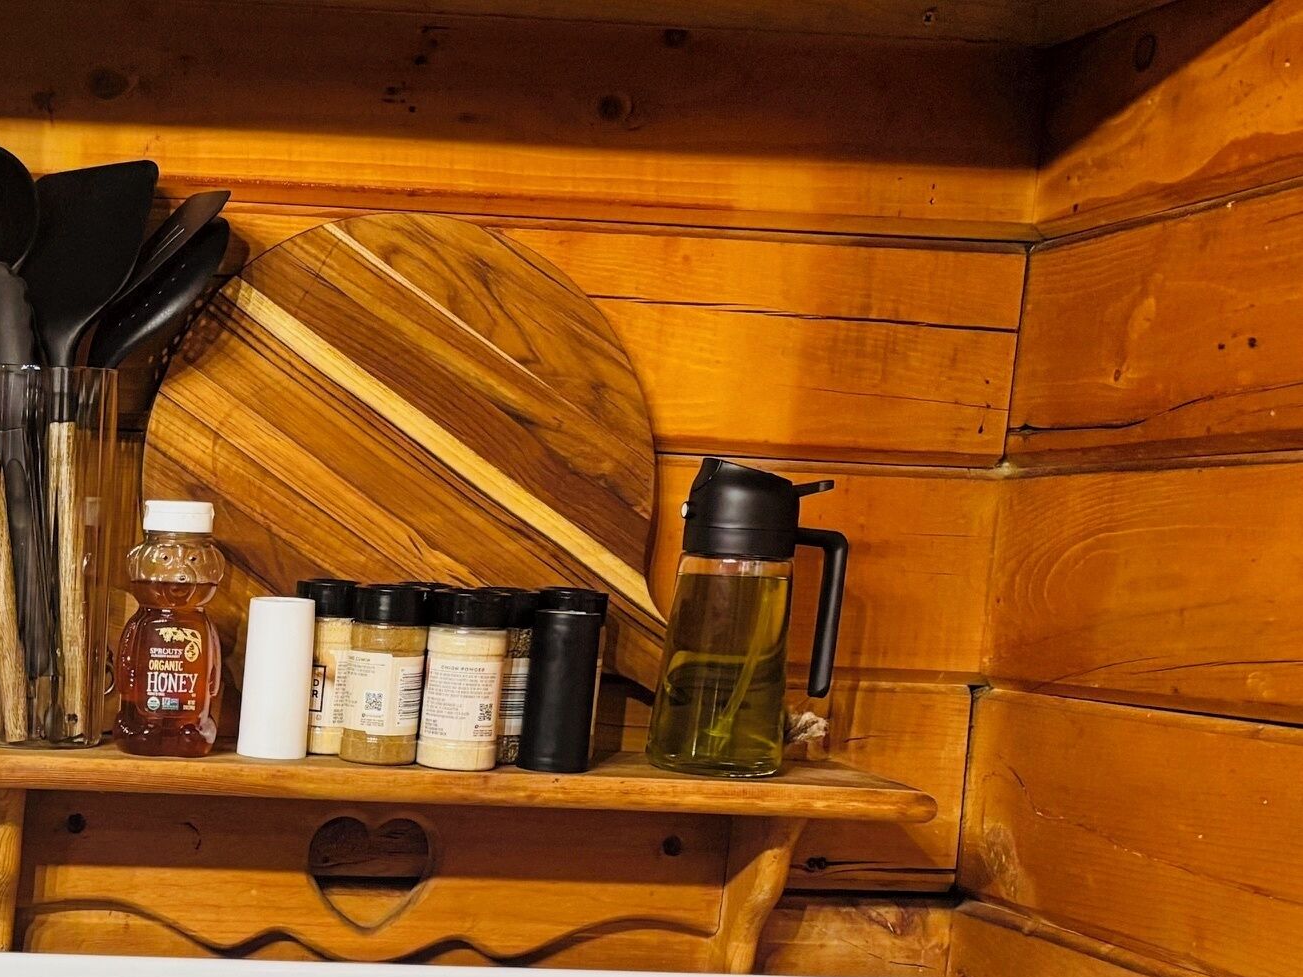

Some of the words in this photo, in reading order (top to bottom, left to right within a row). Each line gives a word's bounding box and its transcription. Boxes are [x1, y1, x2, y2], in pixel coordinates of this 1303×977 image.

[149, 648, 184, 656] SPROUTS
[148, 660, 184, 671] ORGANIC
[146, 672, 198, 693] HONEY
